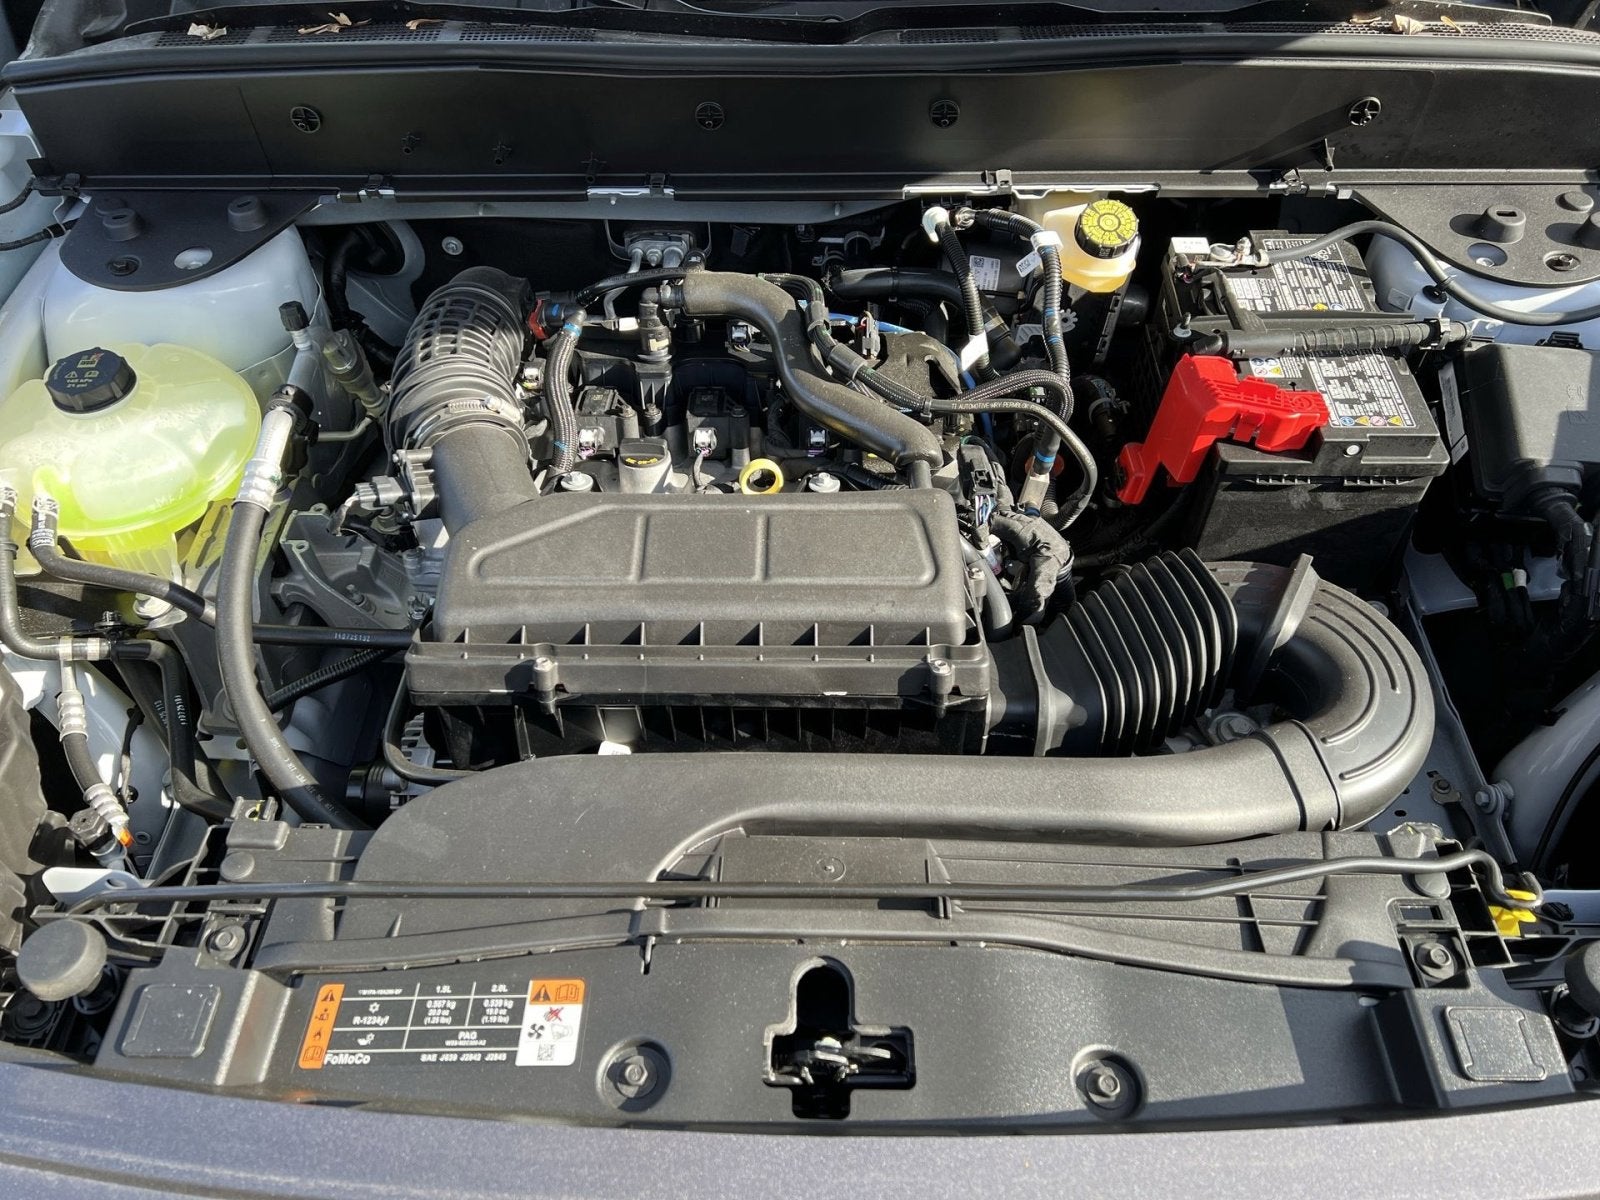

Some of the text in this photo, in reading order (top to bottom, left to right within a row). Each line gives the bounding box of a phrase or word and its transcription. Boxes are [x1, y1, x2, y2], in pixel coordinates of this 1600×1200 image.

[446, 1000, 457, 1010] kg
[503, 999, 514, 1009] kg
[352, 1015, 390, 1027] R-1234yf
[458, 1031, 477, 1040] PAG
[323, 1053, 371, 1065] FoMoCo
[420, 1054, 438, 1062] SAE
